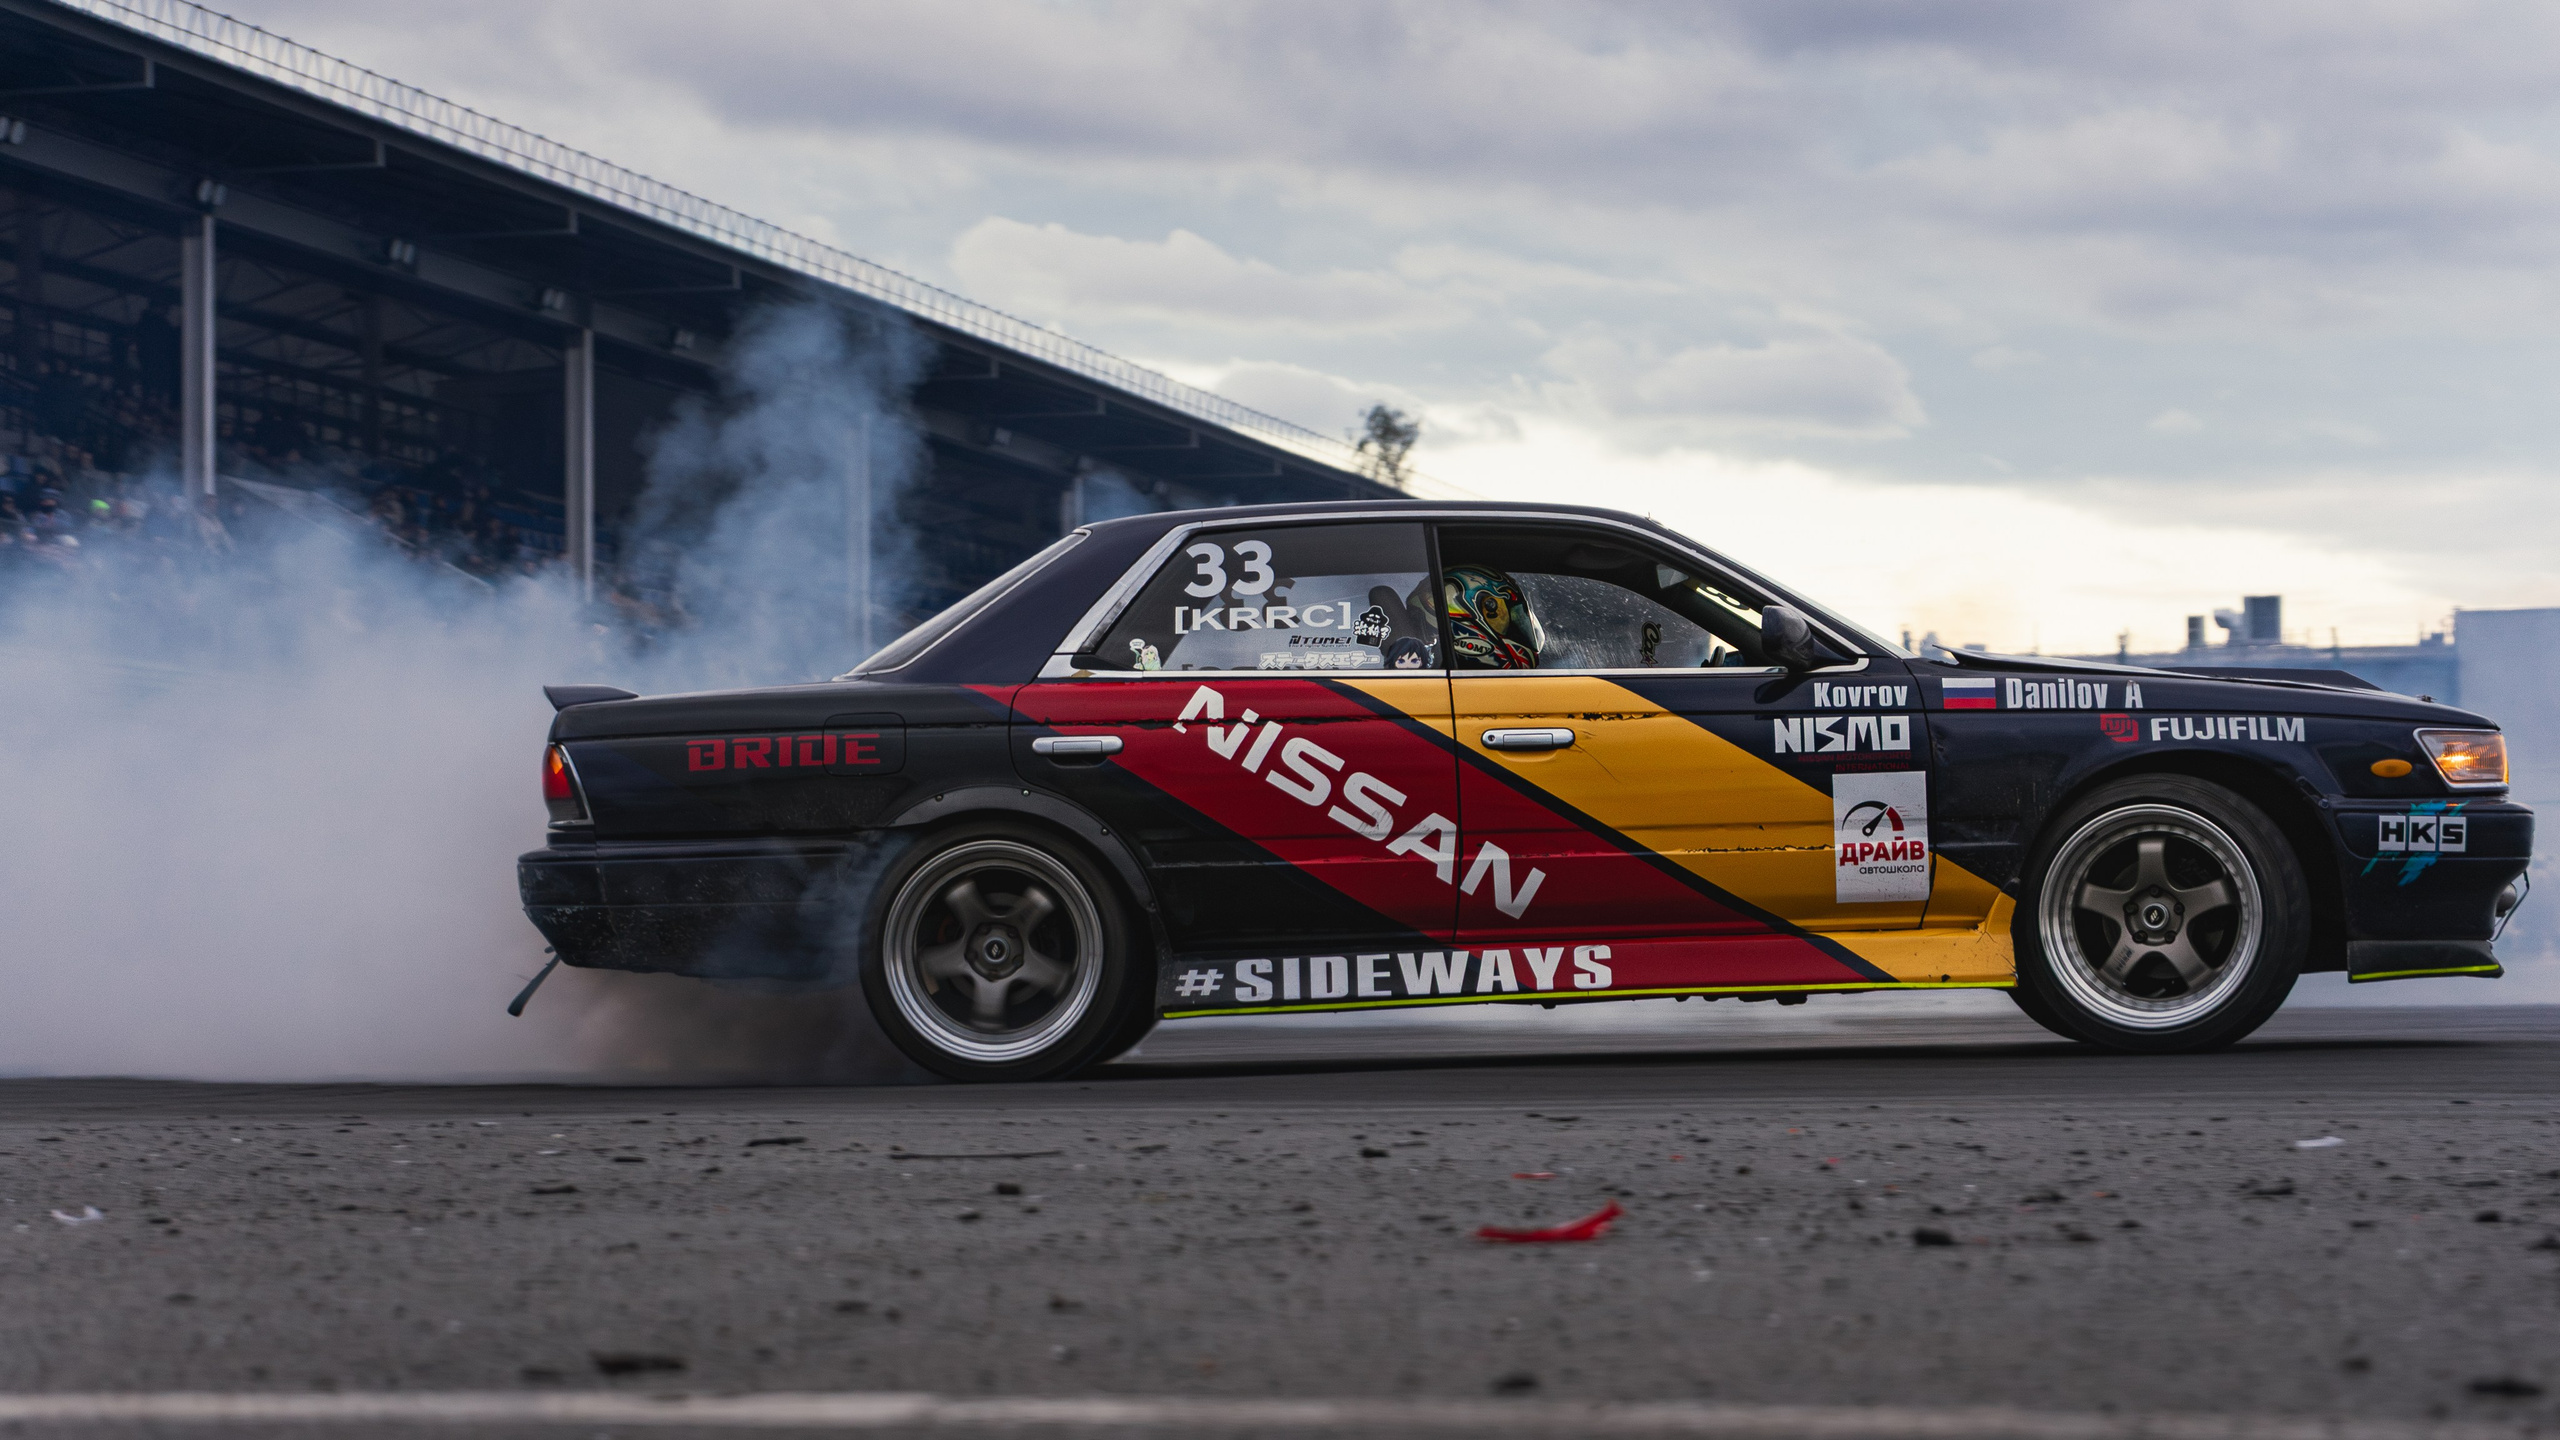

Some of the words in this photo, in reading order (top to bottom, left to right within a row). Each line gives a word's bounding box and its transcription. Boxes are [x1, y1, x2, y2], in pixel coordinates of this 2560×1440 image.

[1184, 540, 1275, 598] 33
[1175, 601, 1351, 634] [KRRC]
[1454, 640, 1492, 653] SUOMY
[1814, 682, 1908, 708] Kovrov
[2005, 678, 2108, 709] Danilov
[2124, 680, 2144, 709] A
[1774, 716, 1911, 753] NISMO
[2151, 717, 2306, 742] FUJIFILM
[686, 733, 881, 772] BRIDE
[1836, 762, 1911, 771] INTERNATIONAL
[1172, 684, 1547, 920] NISSAN
[2380, 820, 2464, 845] HKS
[1840, 836, 1925, 866] ДРАЙВ
[1859, 864, 1925, 875] автошкола
